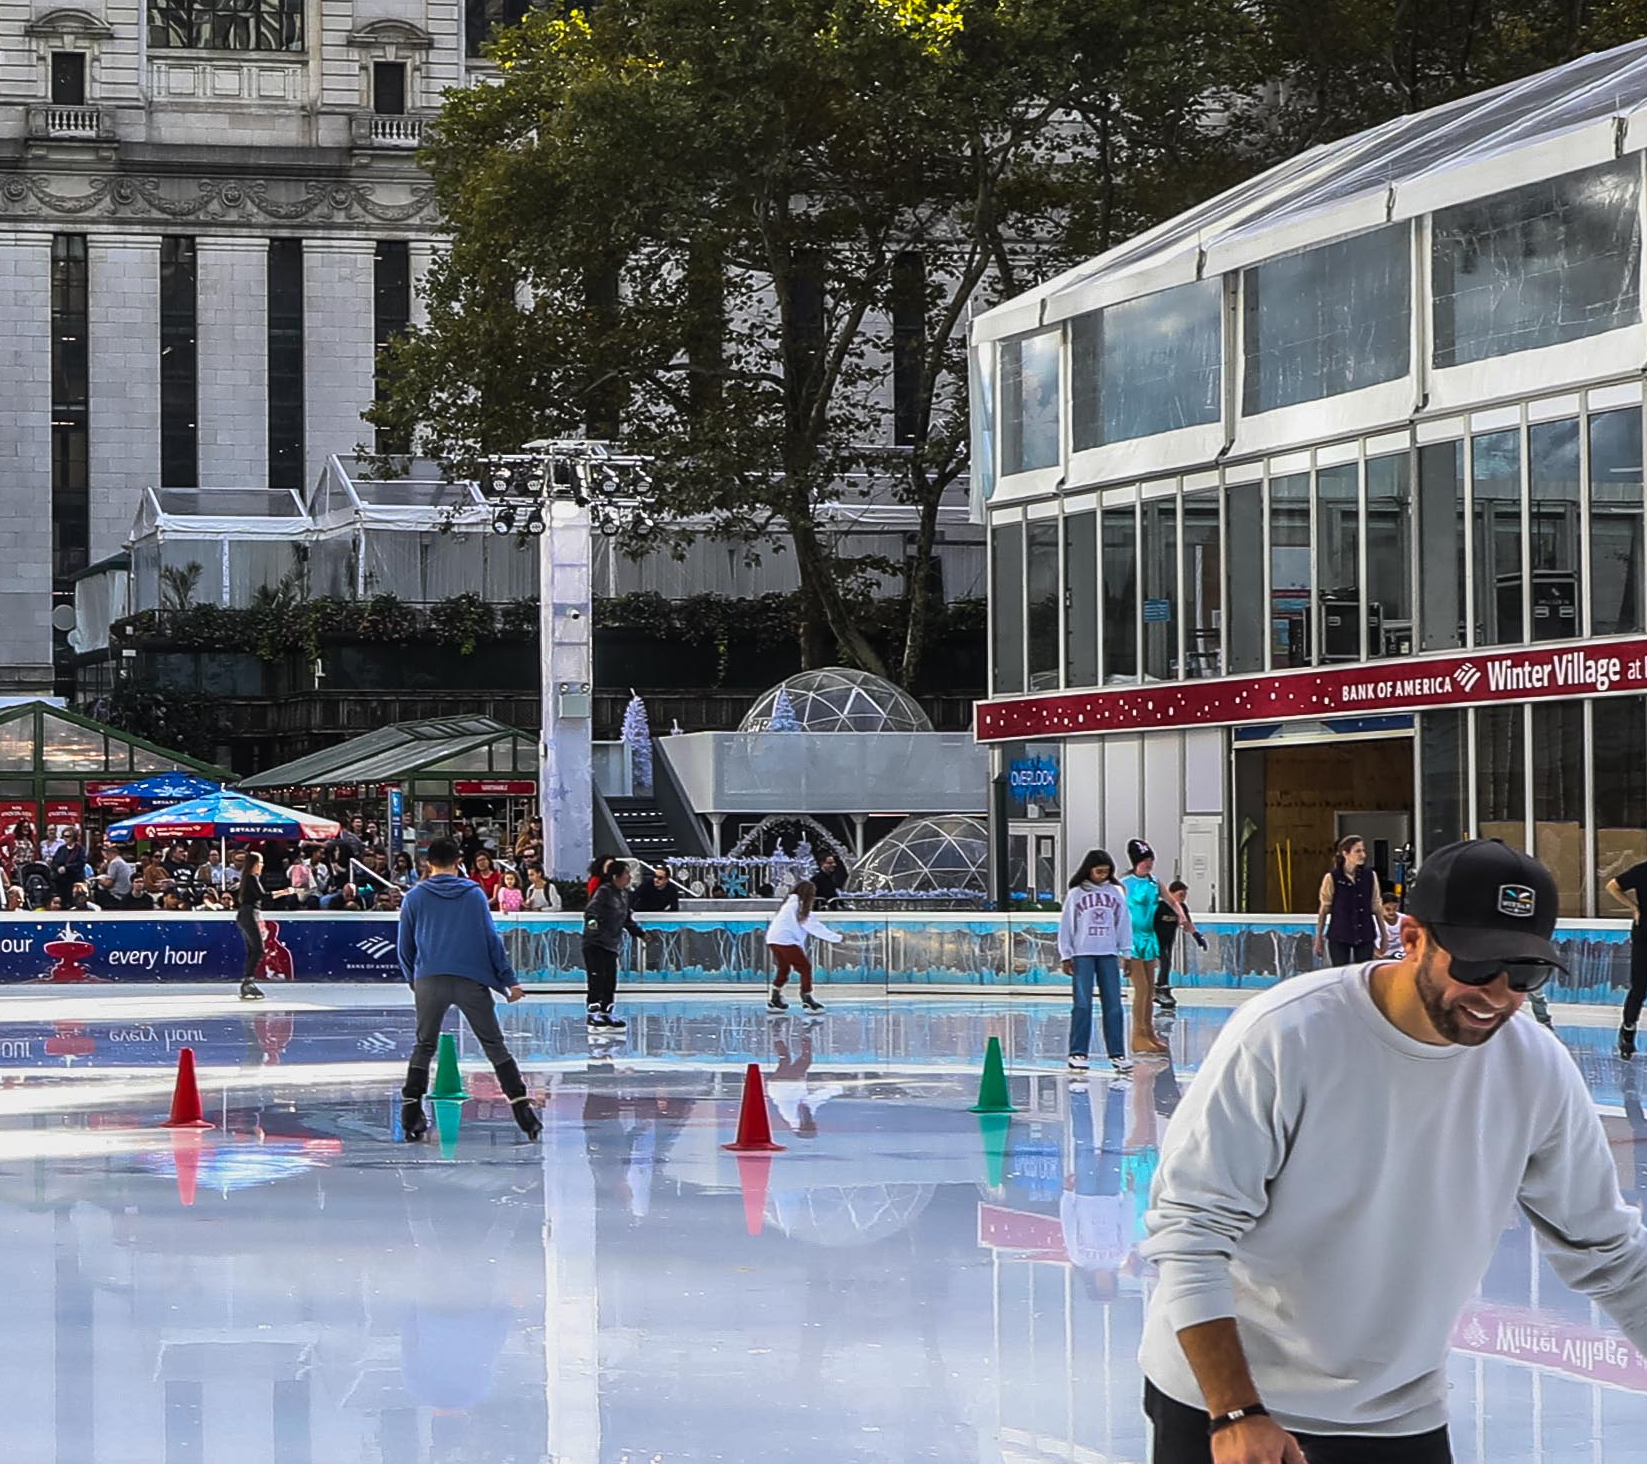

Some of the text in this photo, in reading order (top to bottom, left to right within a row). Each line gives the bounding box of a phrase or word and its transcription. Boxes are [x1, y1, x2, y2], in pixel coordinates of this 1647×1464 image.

[1341, 684, 1375, 702] BANK
[1377, 681, 1393, 698] OF
[1395, 676, 1453, 697] AMERICA
[1486, 658, 1552, 692] Winter
[1552, 650, 1620, 691] Village
[1627, 662, 1644, 681] at
[1076, 893, 1121, 916] MIAMI
[109, 949, 158, 968] every
[163, 945, 207, 965] hour
